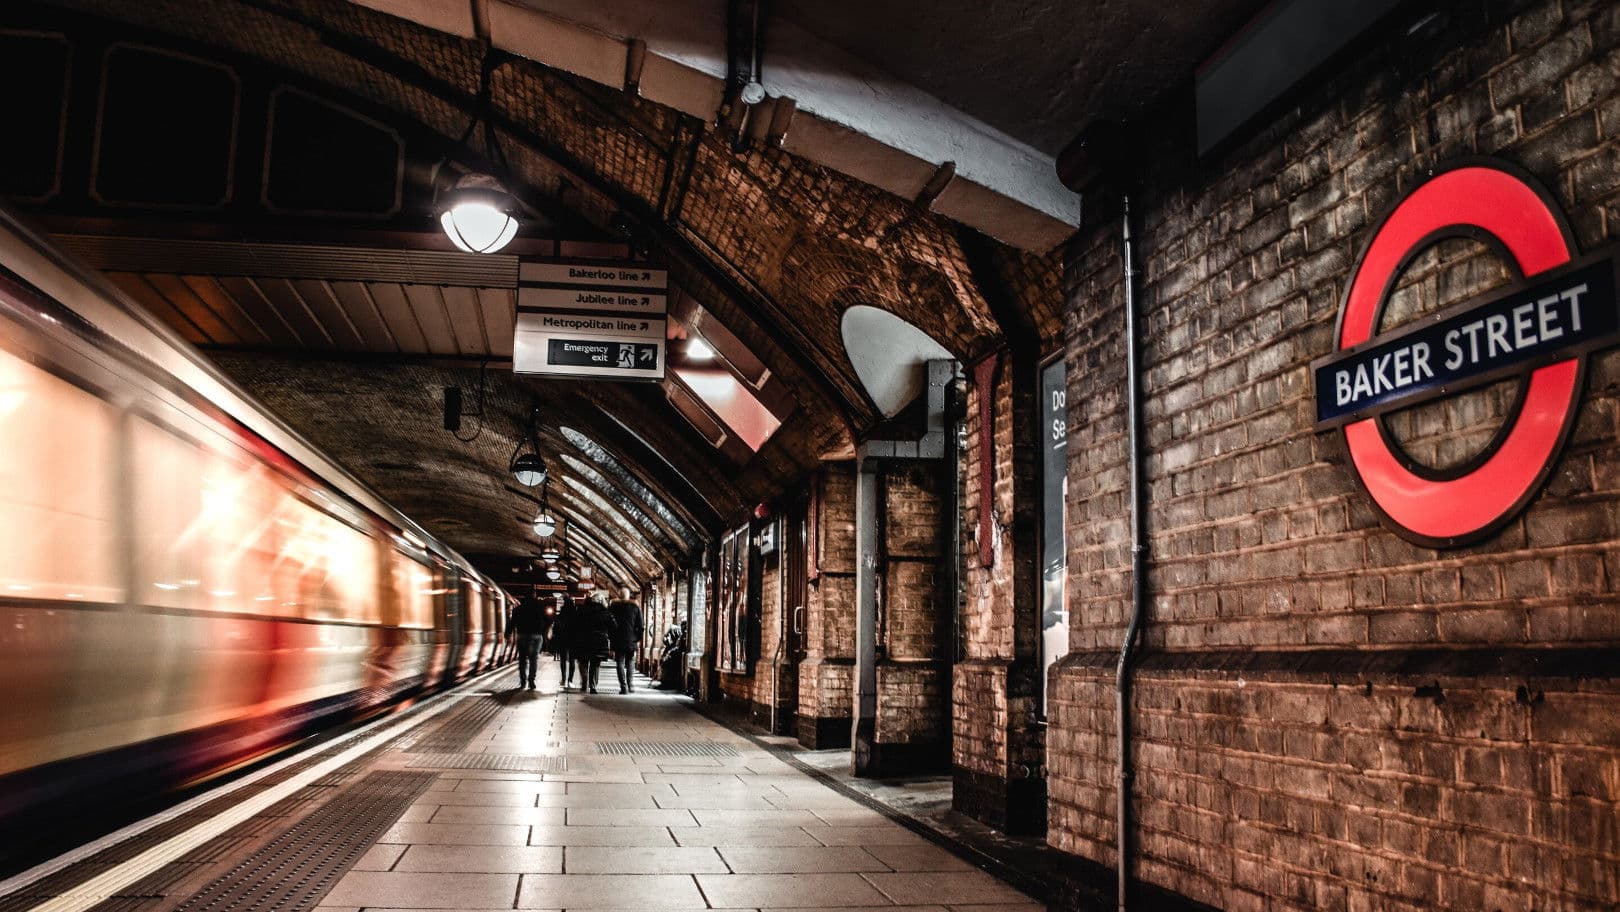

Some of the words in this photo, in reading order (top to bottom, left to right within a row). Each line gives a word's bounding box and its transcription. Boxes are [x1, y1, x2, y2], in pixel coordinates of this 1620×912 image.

[569, 268, 615, 280] Bakerloo
[619, 271, 638, 281] line
[576, 294, 614, 305] Jubilee
[618, 296, 638, 306] line
[543, 317, 614, 330] Metropolitan
[617, 320, 637, 331] line
[564, 344, 608, 354] Emergency
[1335, 341, 1435, 407] BAKER
[1444, 283, 1588, 371] STREET
[592, 353, 608, 362] exit
